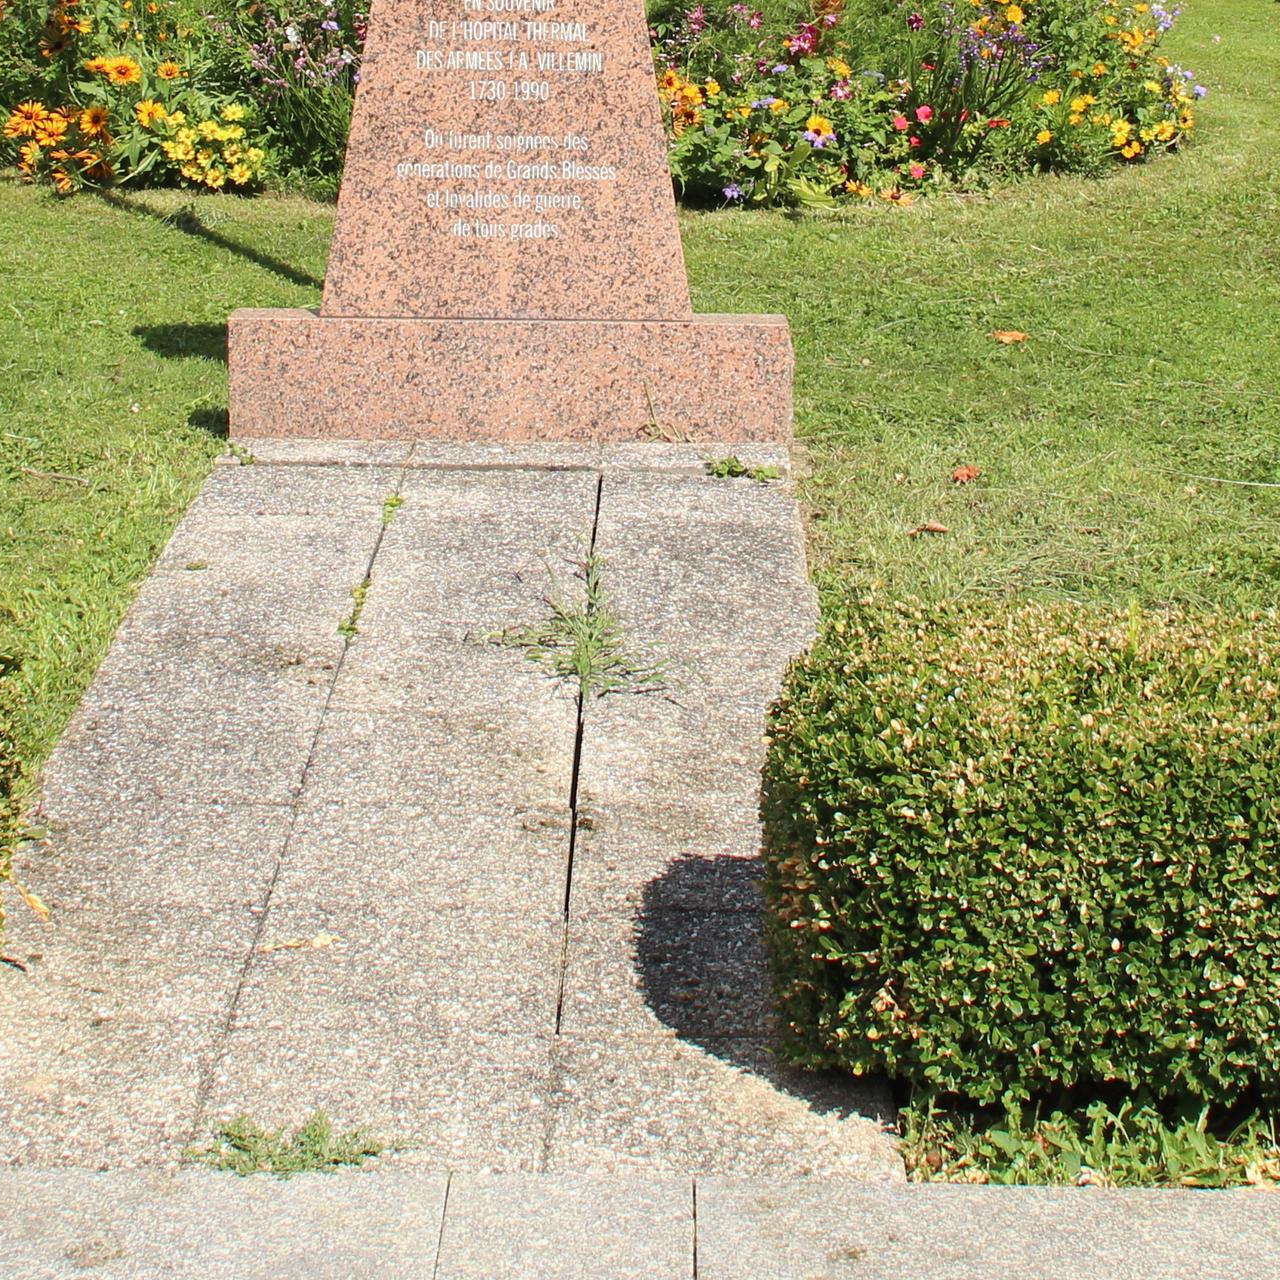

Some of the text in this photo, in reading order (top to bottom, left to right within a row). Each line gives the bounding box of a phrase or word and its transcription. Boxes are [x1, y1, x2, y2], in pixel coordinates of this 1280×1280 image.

[428, 20, 447, 40] DE
[524, 21, 590, 42] THERMAL
[416, 50, 442, 70] DES
[537, 51, 604, 71] VILLEMIN
[449, 130, 491, 150] furent
[563, 132, 589, 151] des
[484, 160, 502, 179] de
[506, 160, 558, 180] Grands
[426, 190, 440, 209] et
[446, 190, 509, 209] Invalides
[513, 190, 531, 209] de
[453, 219, 471, 238] de
[475, 219, 506, 239] tous
